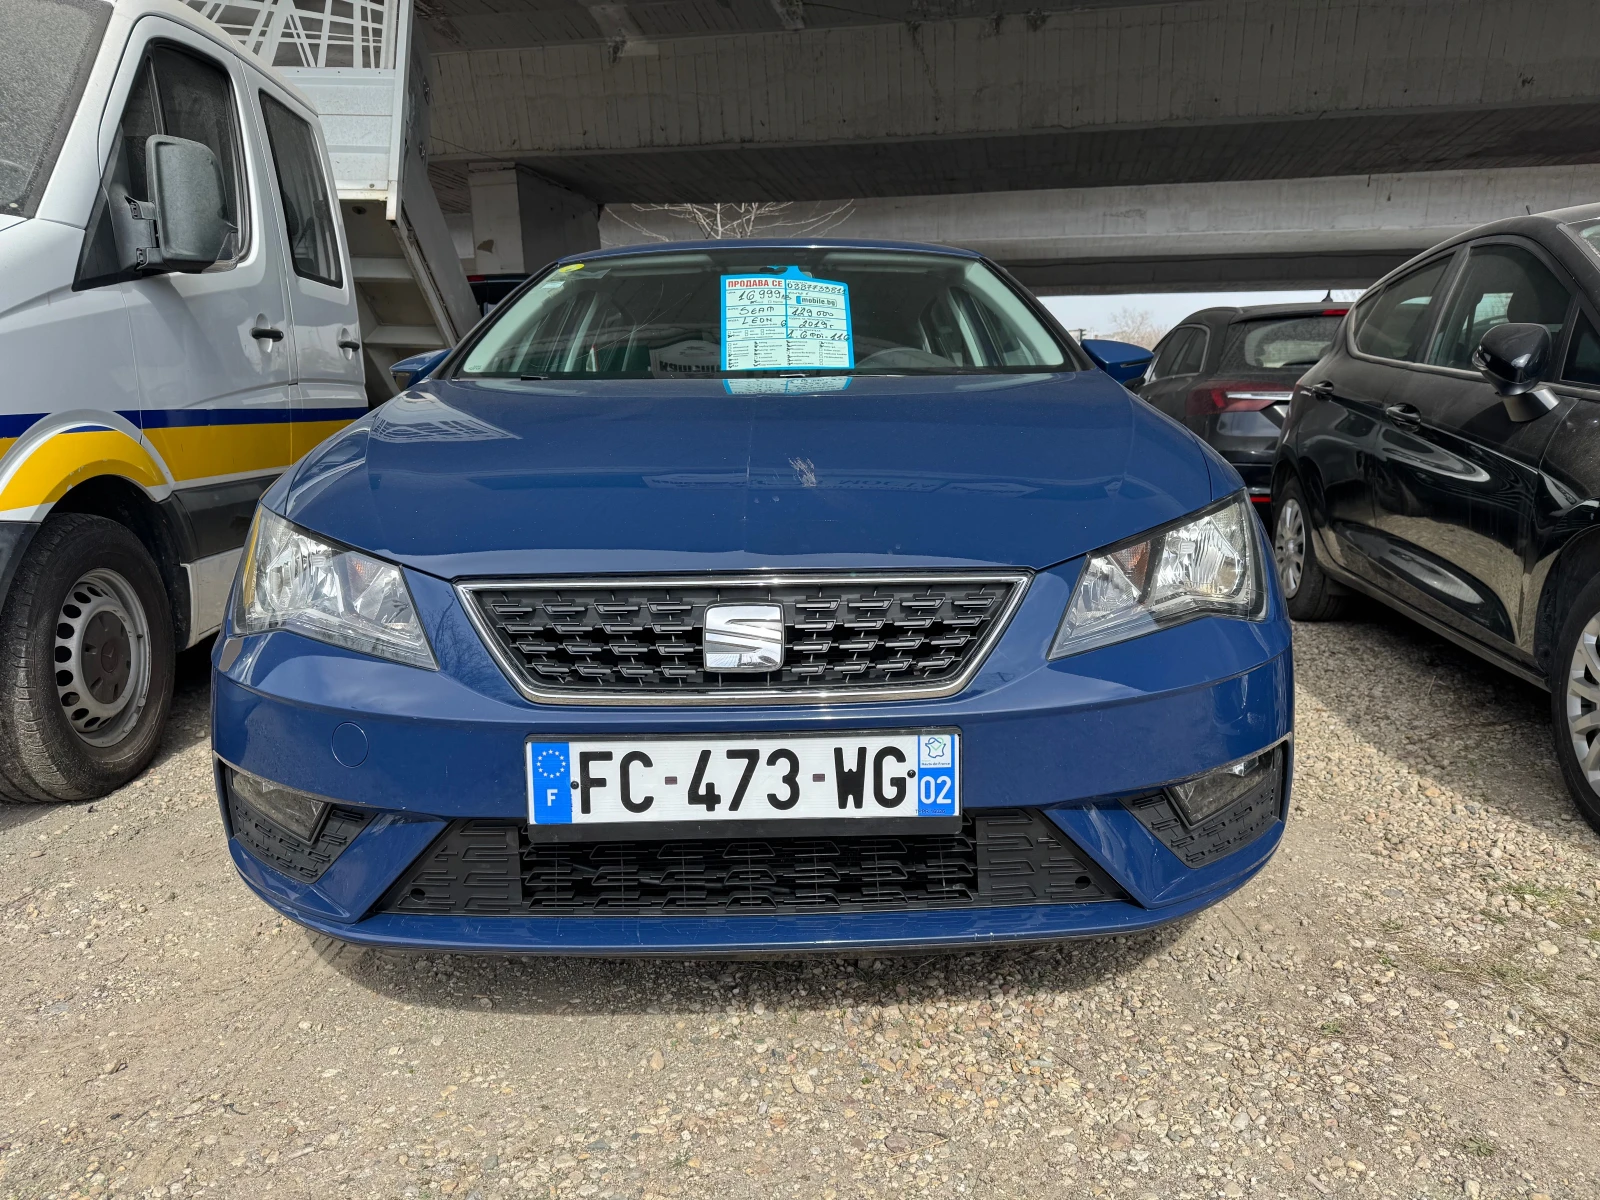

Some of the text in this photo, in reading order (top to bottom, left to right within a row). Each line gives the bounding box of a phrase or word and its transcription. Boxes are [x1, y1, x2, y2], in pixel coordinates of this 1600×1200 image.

[801, 297, 836, 306] mobile.bg
[742, 316, 772, 325] LEON
[799, 320, 827, 329] 2019
[920, 776, 952, 805] 02
[546, 788, 558, 807] F
